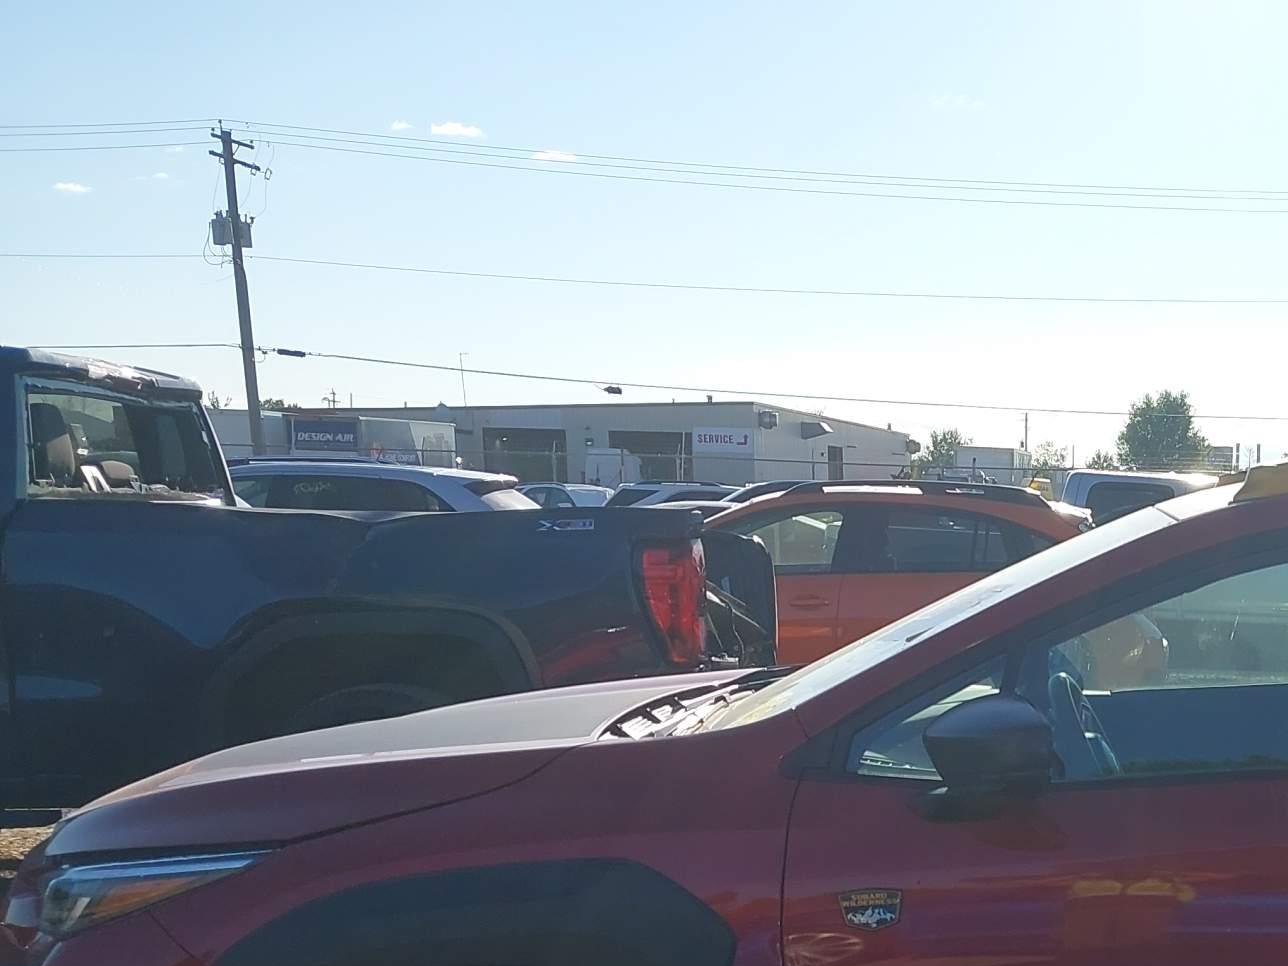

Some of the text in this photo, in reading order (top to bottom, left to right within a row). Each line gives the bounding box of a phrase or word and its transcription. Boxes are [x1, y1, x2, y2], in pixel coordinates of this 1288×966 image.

[297, 432, 354, 442] DESIGN AIR
[697, 433, 735, 444] SERVICE
